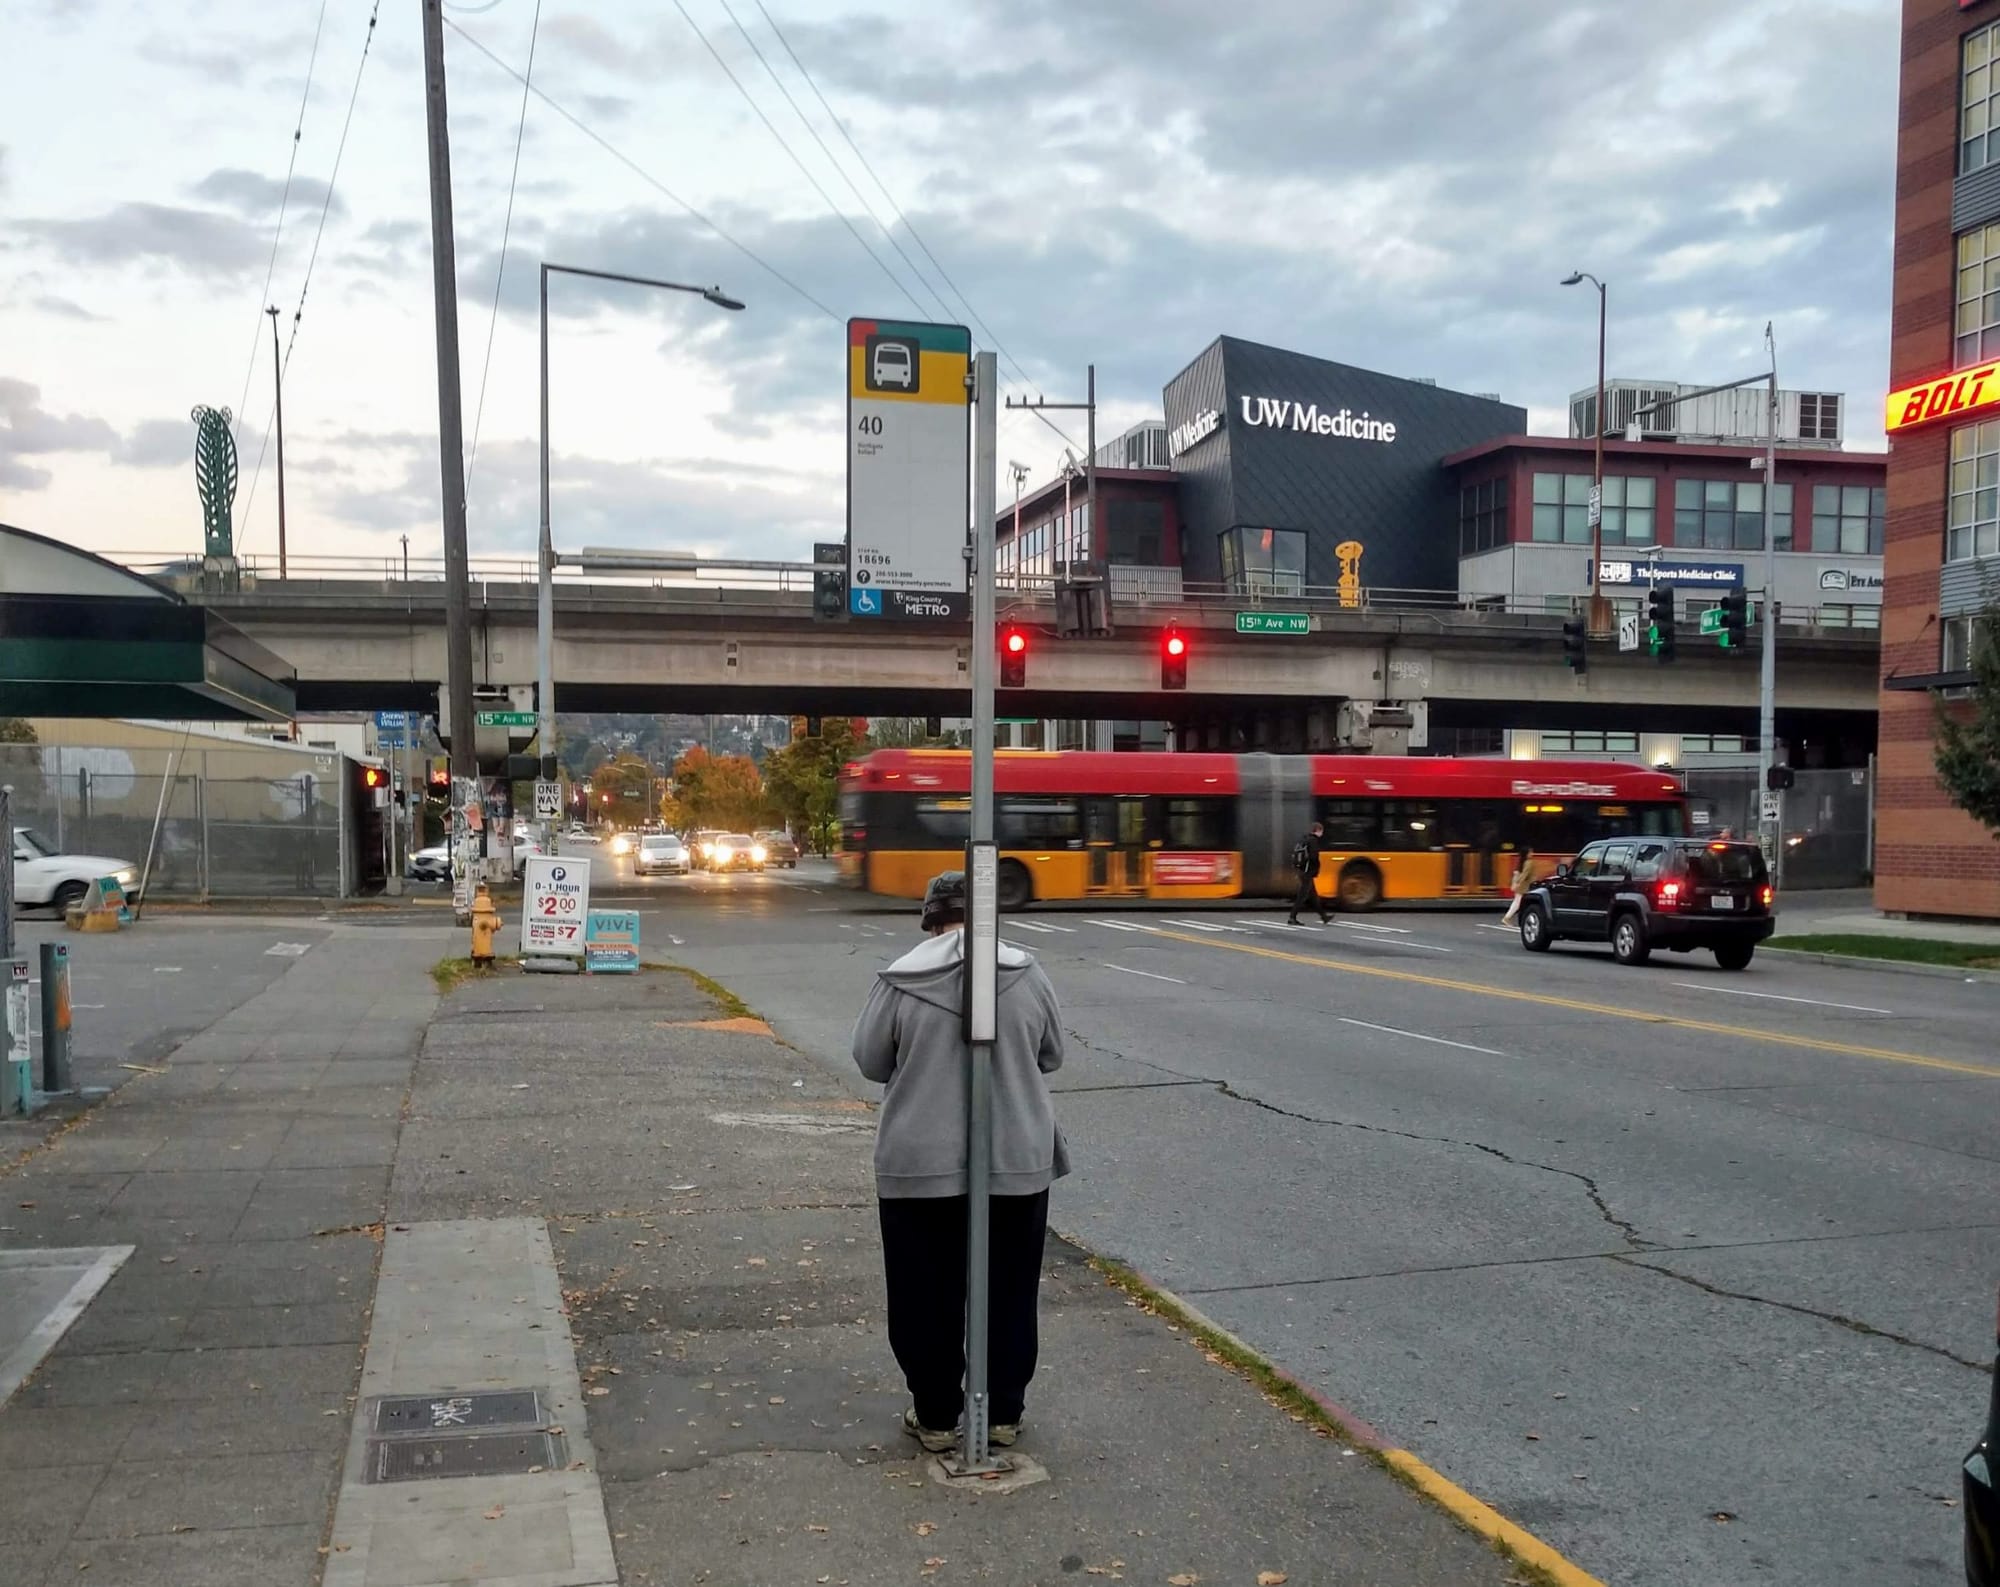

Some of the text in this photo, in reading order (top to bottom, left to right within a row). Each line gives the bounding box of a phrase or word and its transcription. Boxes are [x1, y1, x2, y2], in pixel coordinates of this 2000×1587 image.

[1900, 368, 1995, 425] BOLT
[1241, 396, 1396, 442] UW Medicine
[858, 416, 883, 436] 40
[1168, 408, 1219, 459] UW Medicine
[858, 555, 891, 565] 18696
[1636, 568, 1650, 578] The
[1653, 568, 1677, 580] Sports
[1678, 569, 1712, 580] Medicine
[1713, 570, 1737, 581] Clinic
[905, 595, 942, 604] King County
[905, 604, 950, 616] METRO
[1240, 616, 1307, 628] 15th Ave NW
[522, 715, 535, 723] NW
[538, 785, 559, 795] ONE
[538, 795, 560, 805] WAY
[1763, 793, 1778, 801] ONE
[555, 869, 564, 880] P
[556, 883, 580, 893] HOUR
[558, 926, 577, 939] $7
